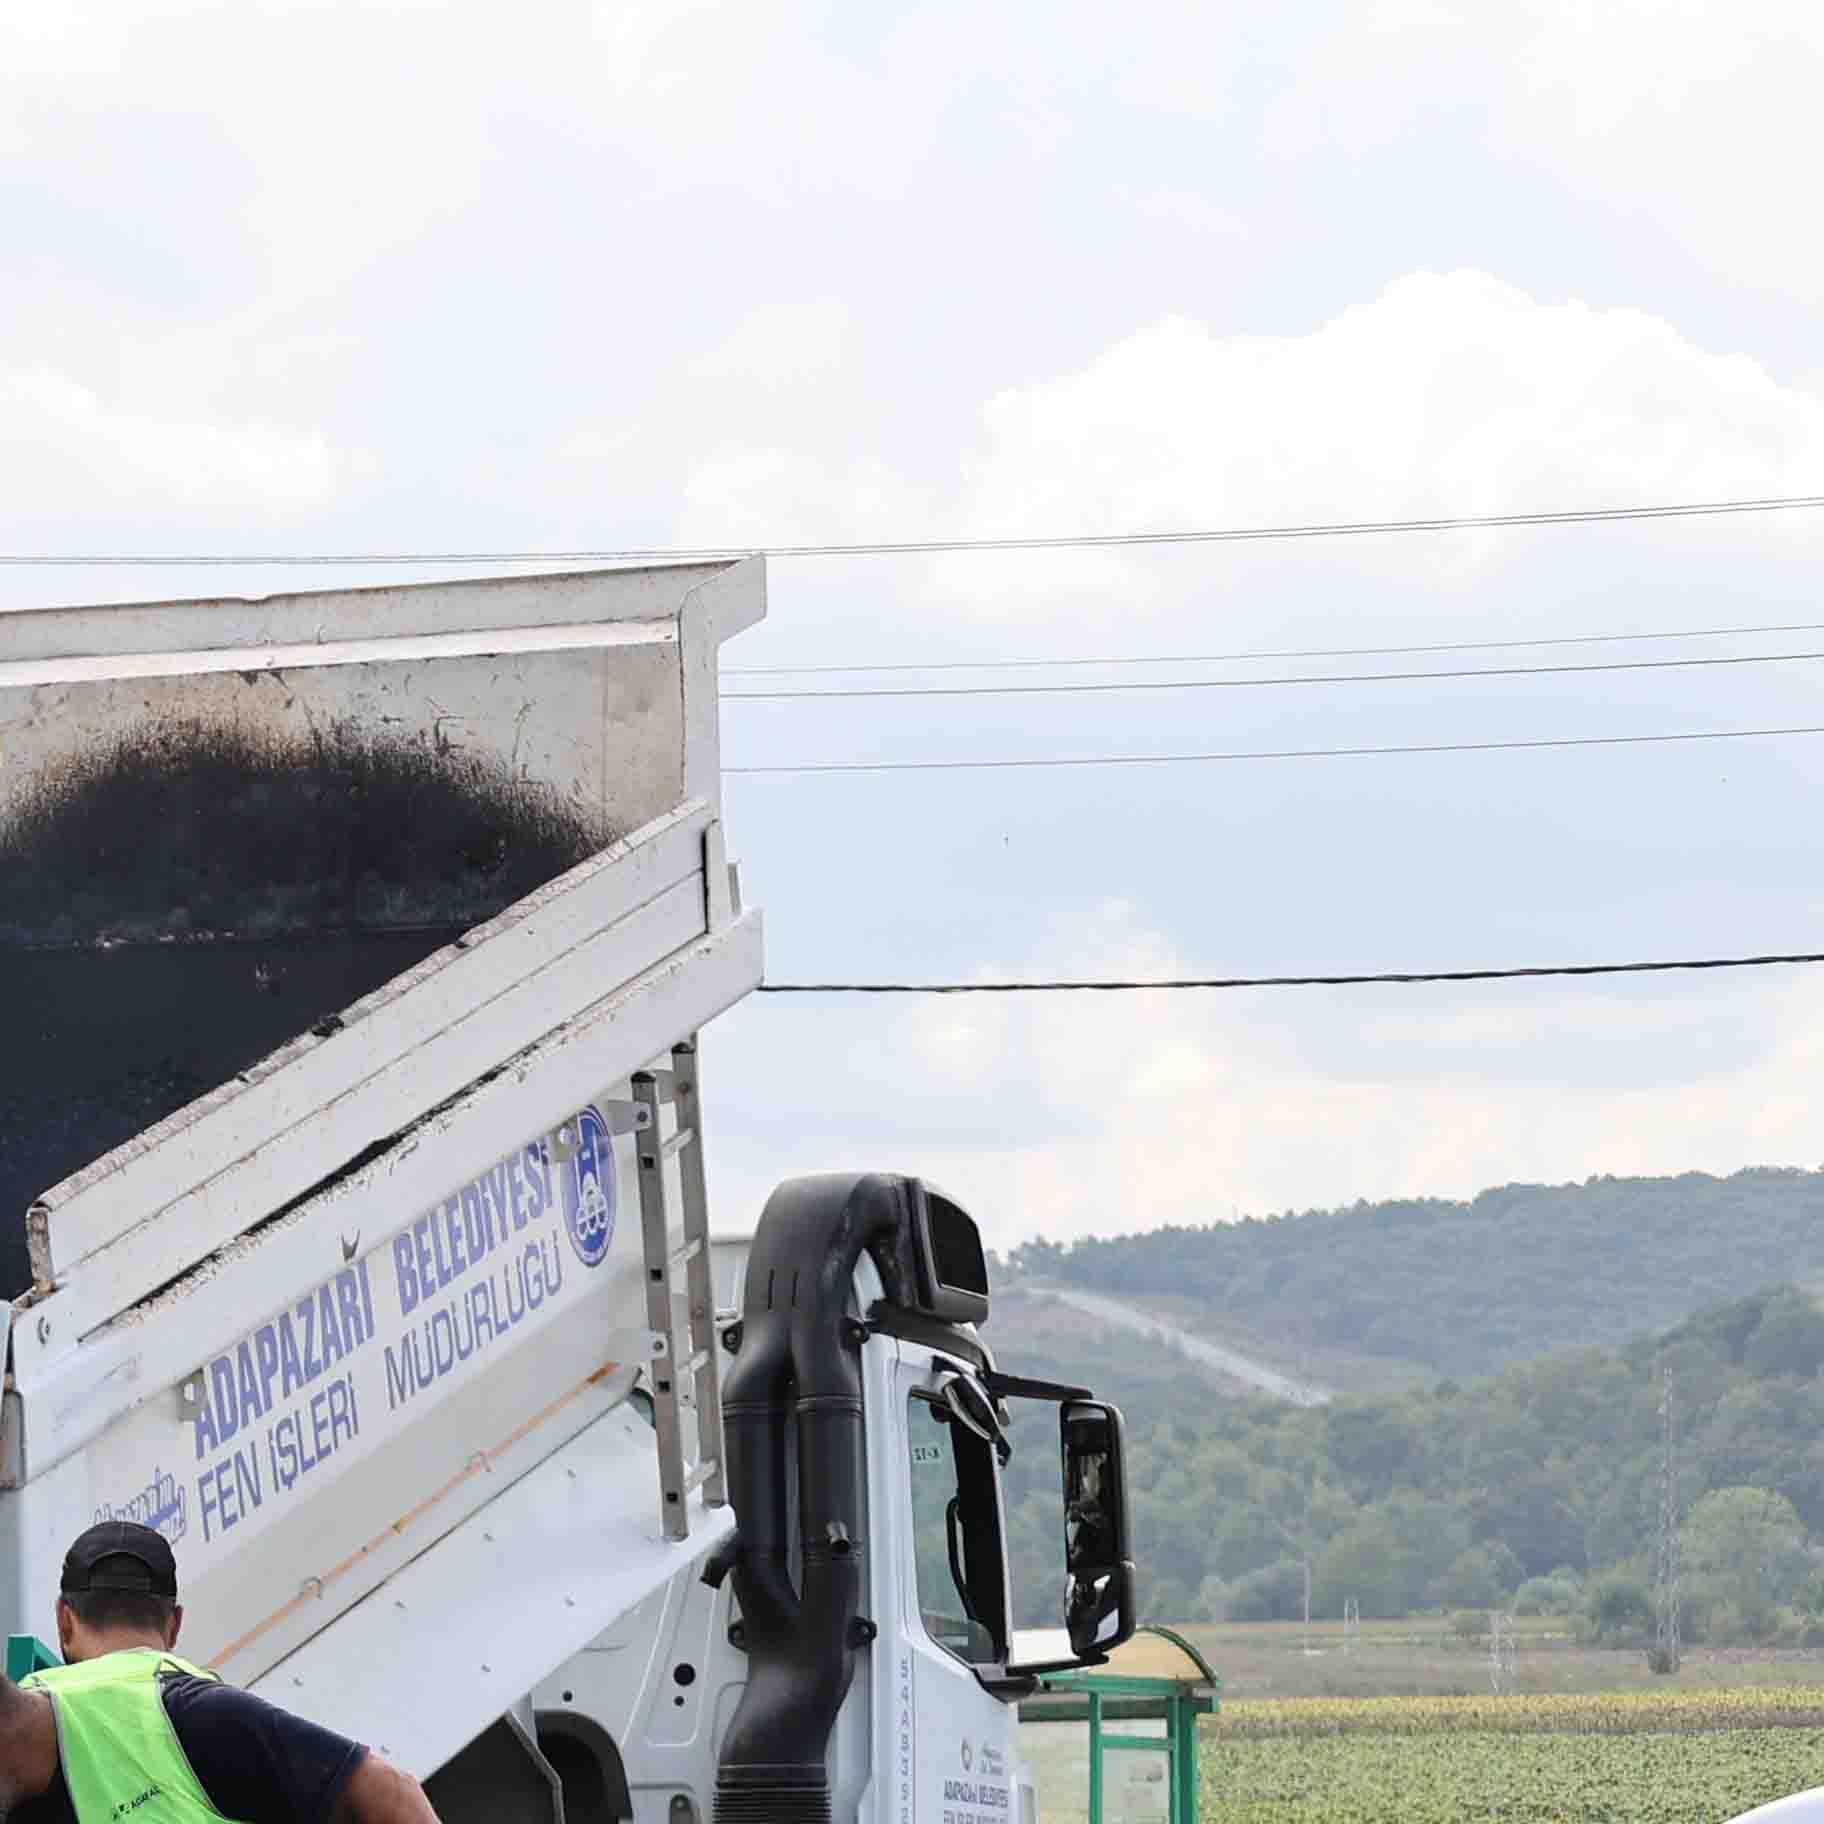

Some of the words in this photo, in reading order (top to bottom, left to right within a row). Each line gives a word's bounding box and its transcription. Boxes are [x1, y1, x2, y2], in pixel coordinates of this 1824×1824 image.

[192, 1258, 375, 1460] ADAPAZARI
[198, 1440, 262, 1543] FEN
[266, 1369, 359, 1494] İŞLERİ
